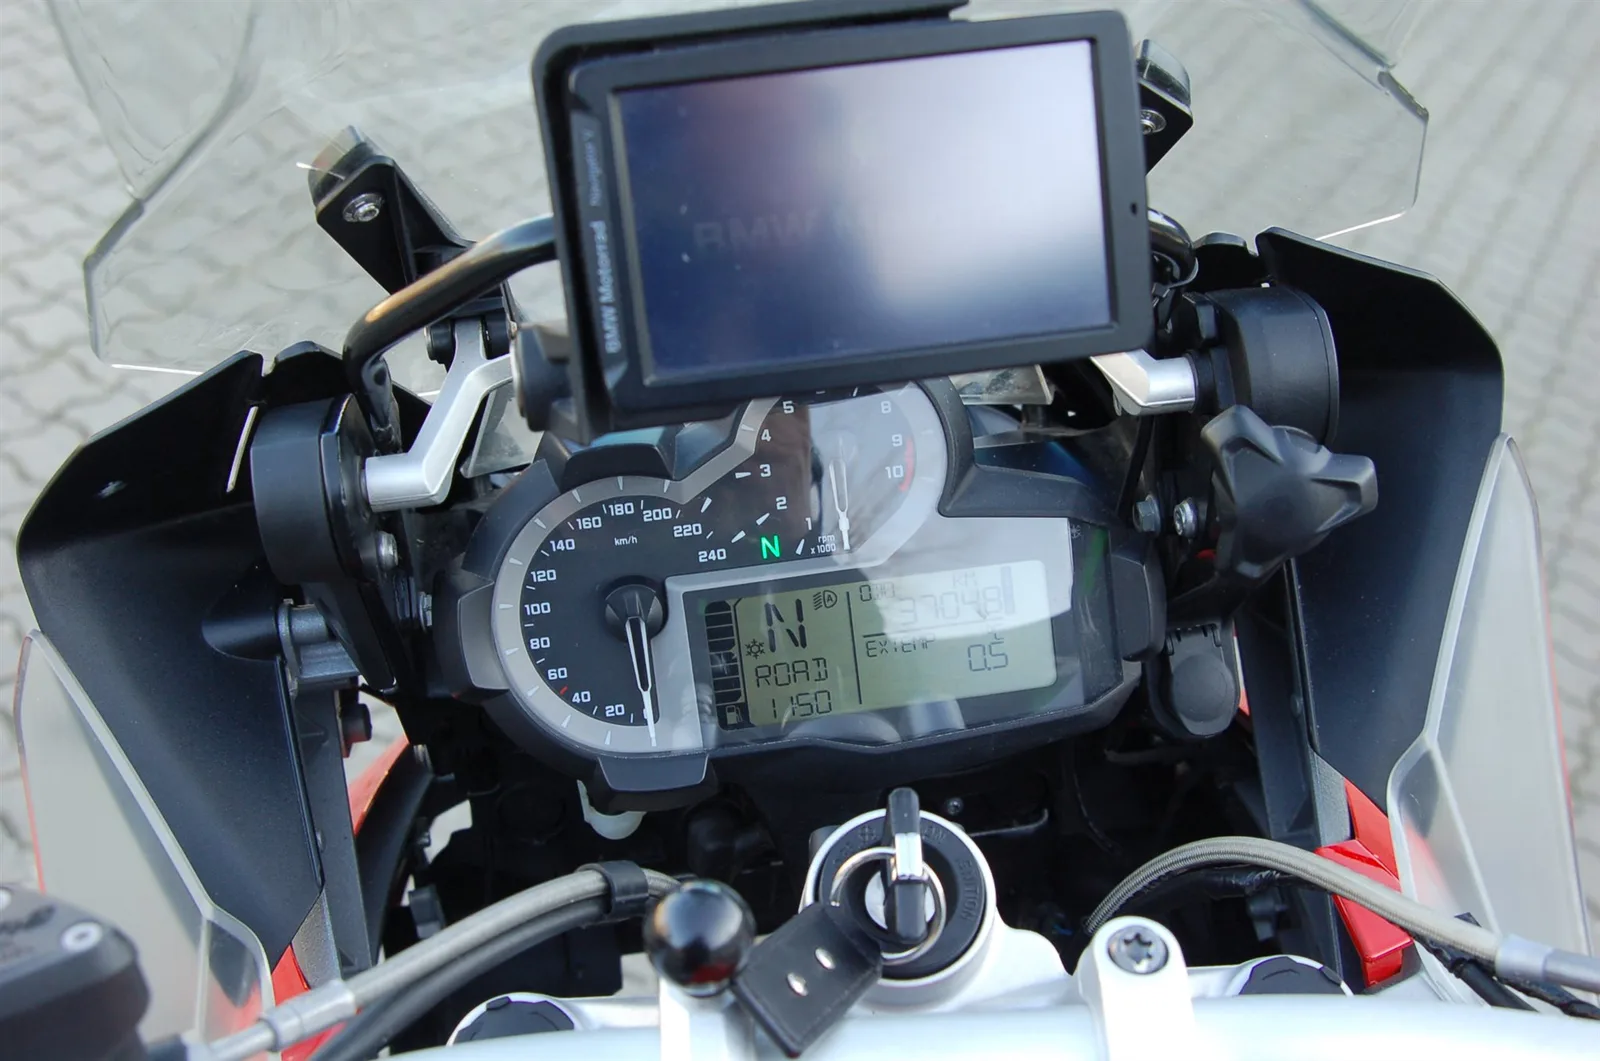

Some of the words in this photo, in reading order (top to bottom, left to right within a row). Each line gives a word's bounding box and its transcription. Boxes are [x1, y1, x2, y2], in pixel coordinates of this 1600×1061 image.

[601, 305, 622, 354] BMW
[782, 400, 795, 414] 5
[880, 400, 892, 414] 8
[760, 428, 772, 442] 4
[891, 433, 903, 447] 9
[759, 463, 772, 478] 3
[885, 464, 904, 479] 10
[608, 501, 635, 517] 180
[775, 495, 788, 511] 2
[642, 507, 672, 522] 200
[576, 516, 603, 530] 160
[673, 522, 703, 538] 220
[804, 516, 813, 531] 1
[549, 538, 576, 552] 140
[614, 535, 638, 546] km/h
[760, 534, 782, 560] N
[817, 534, 836, 546] rpm
[698, 548, 727, 563] 240
[530, 569, 557, 583] 120
[524, 601, 551, 616] 100
[764, 598, 808, 653] N
[529, 636, 551, 650] 80
[547, 667, 568, 681] 60
[754, 656, 829, 689] ROAD
[572, 690, 591, 703] 40
[605, 703, 625, 717] 20
